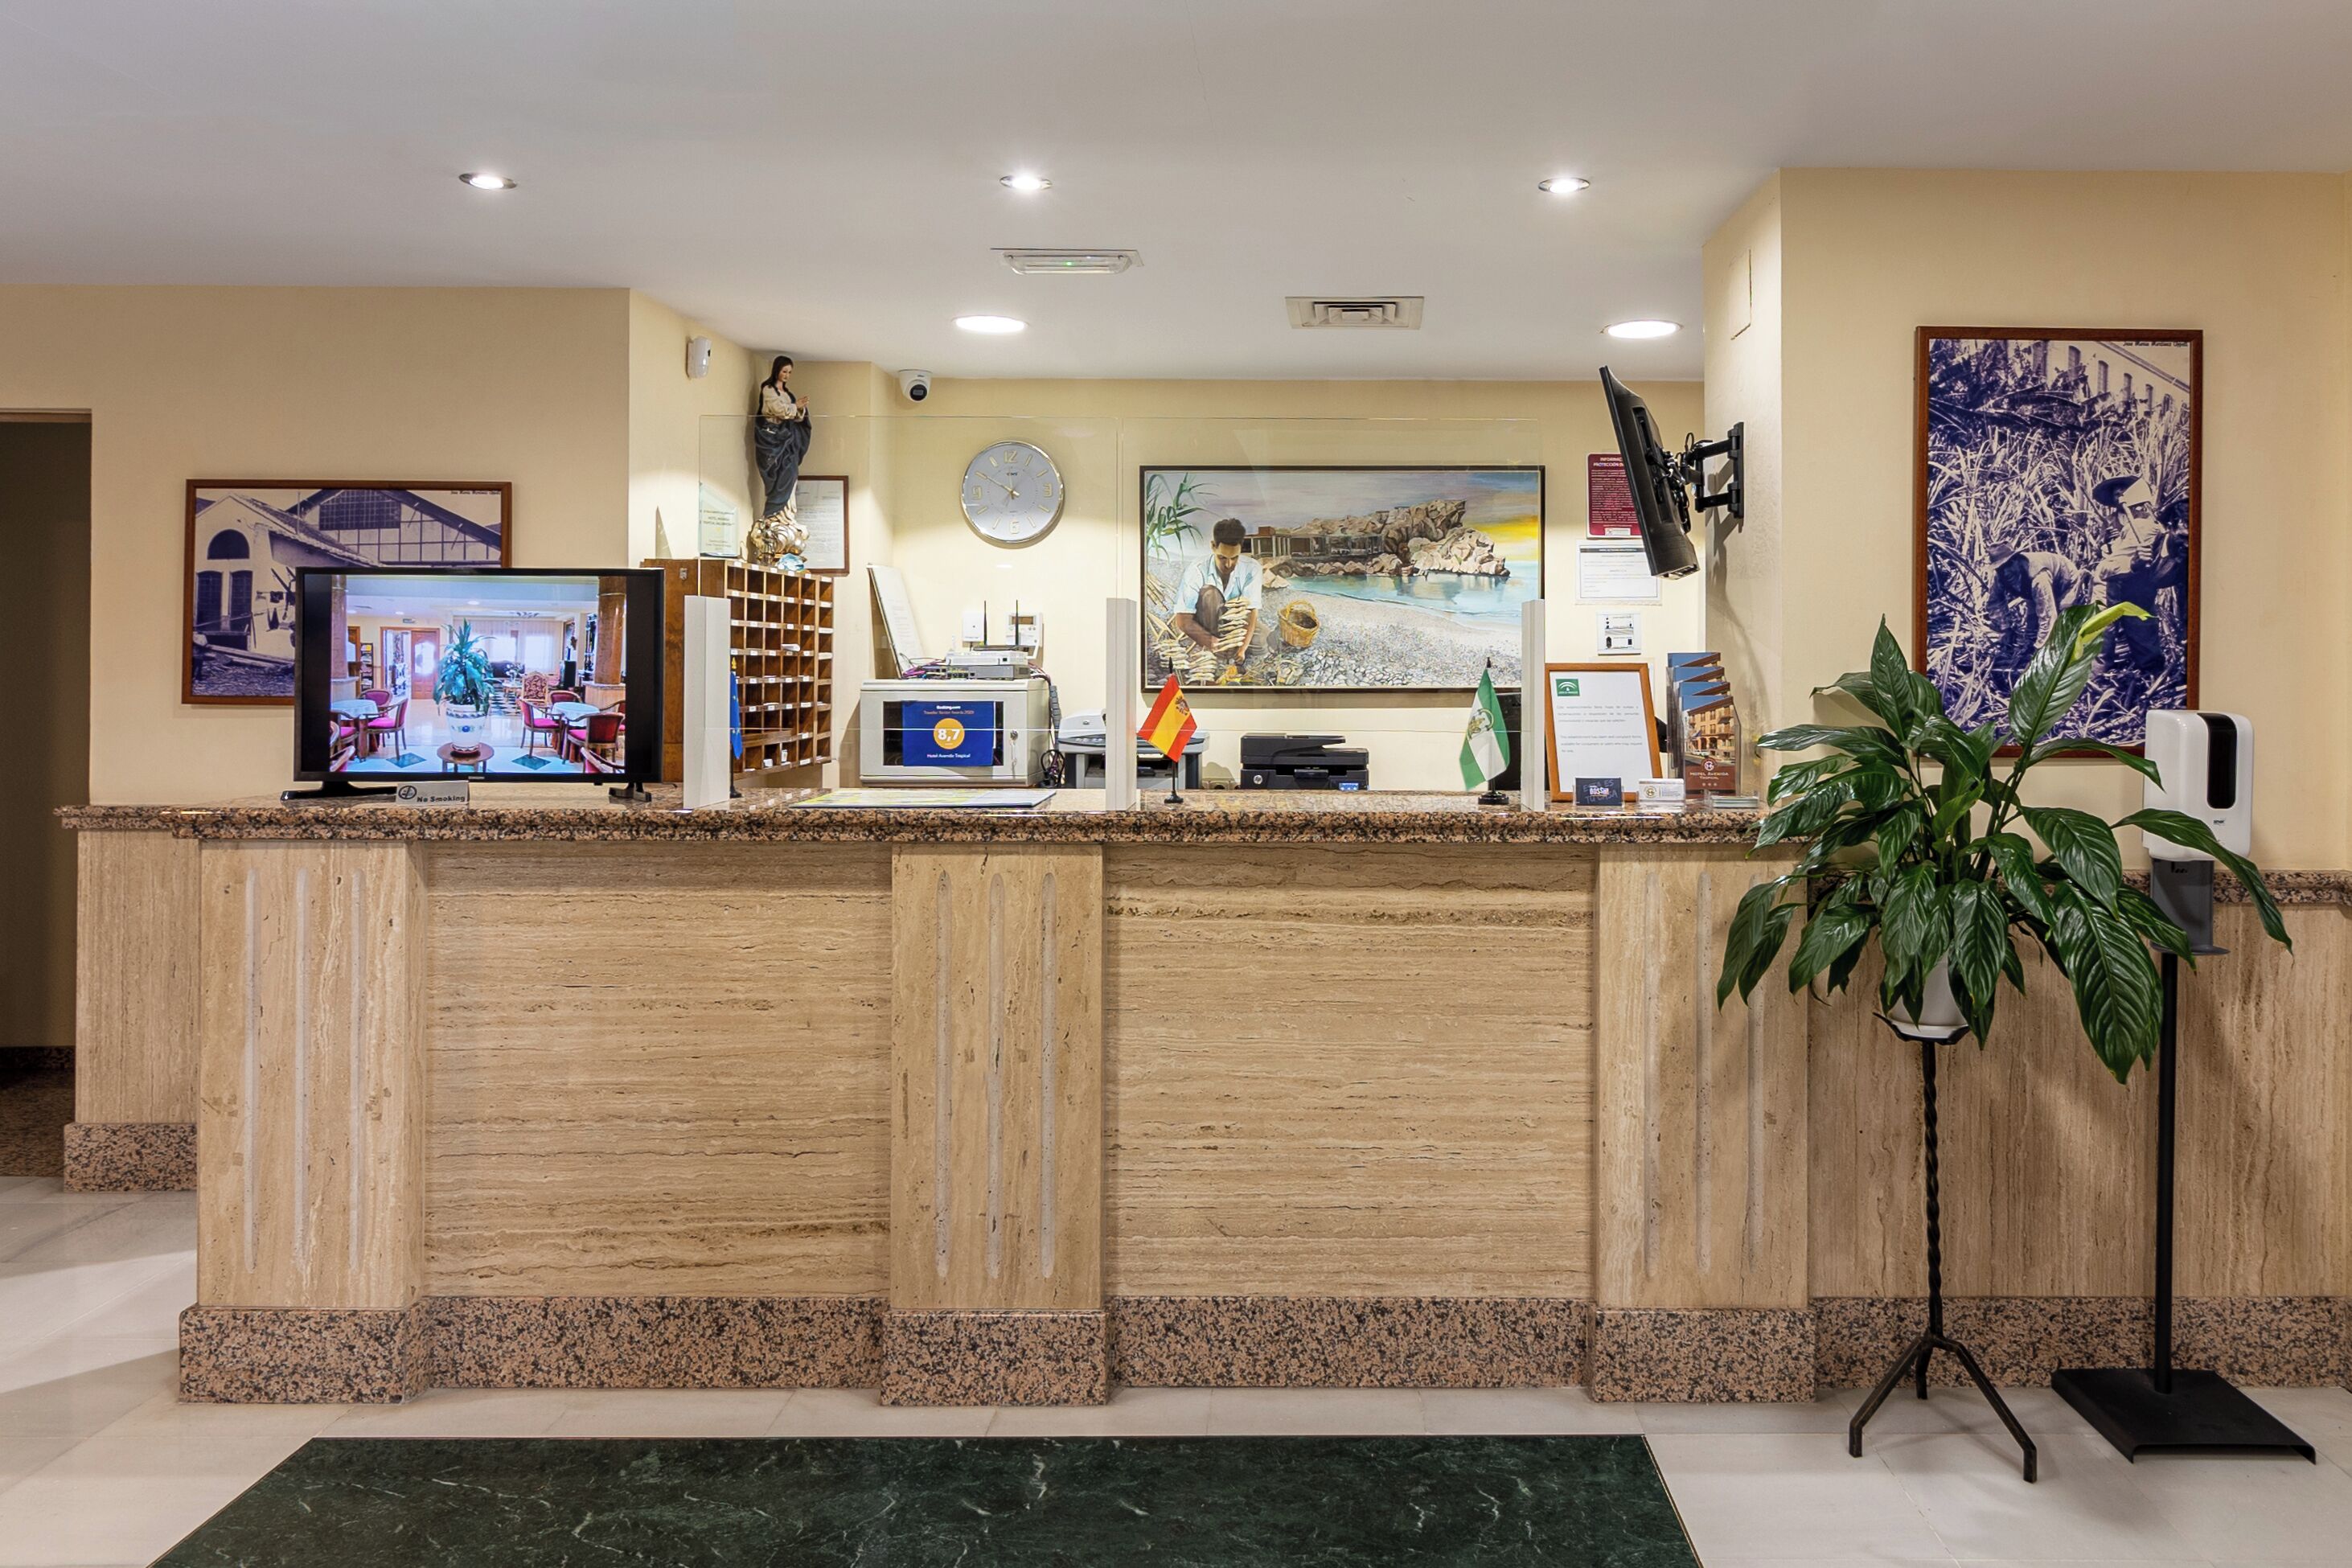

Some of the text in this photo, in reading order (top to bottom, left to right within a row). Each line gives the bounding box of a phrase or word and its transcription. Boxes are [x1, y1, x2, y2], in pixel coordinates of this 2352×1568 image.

[1004, 450, 1018, 463] 12
[972, 486, 983, 500] 9
[1044, 483, 1053, 498] 3
[1010, 519, 1020, 535] 6
[938, 729, 960, 741] 8,7
